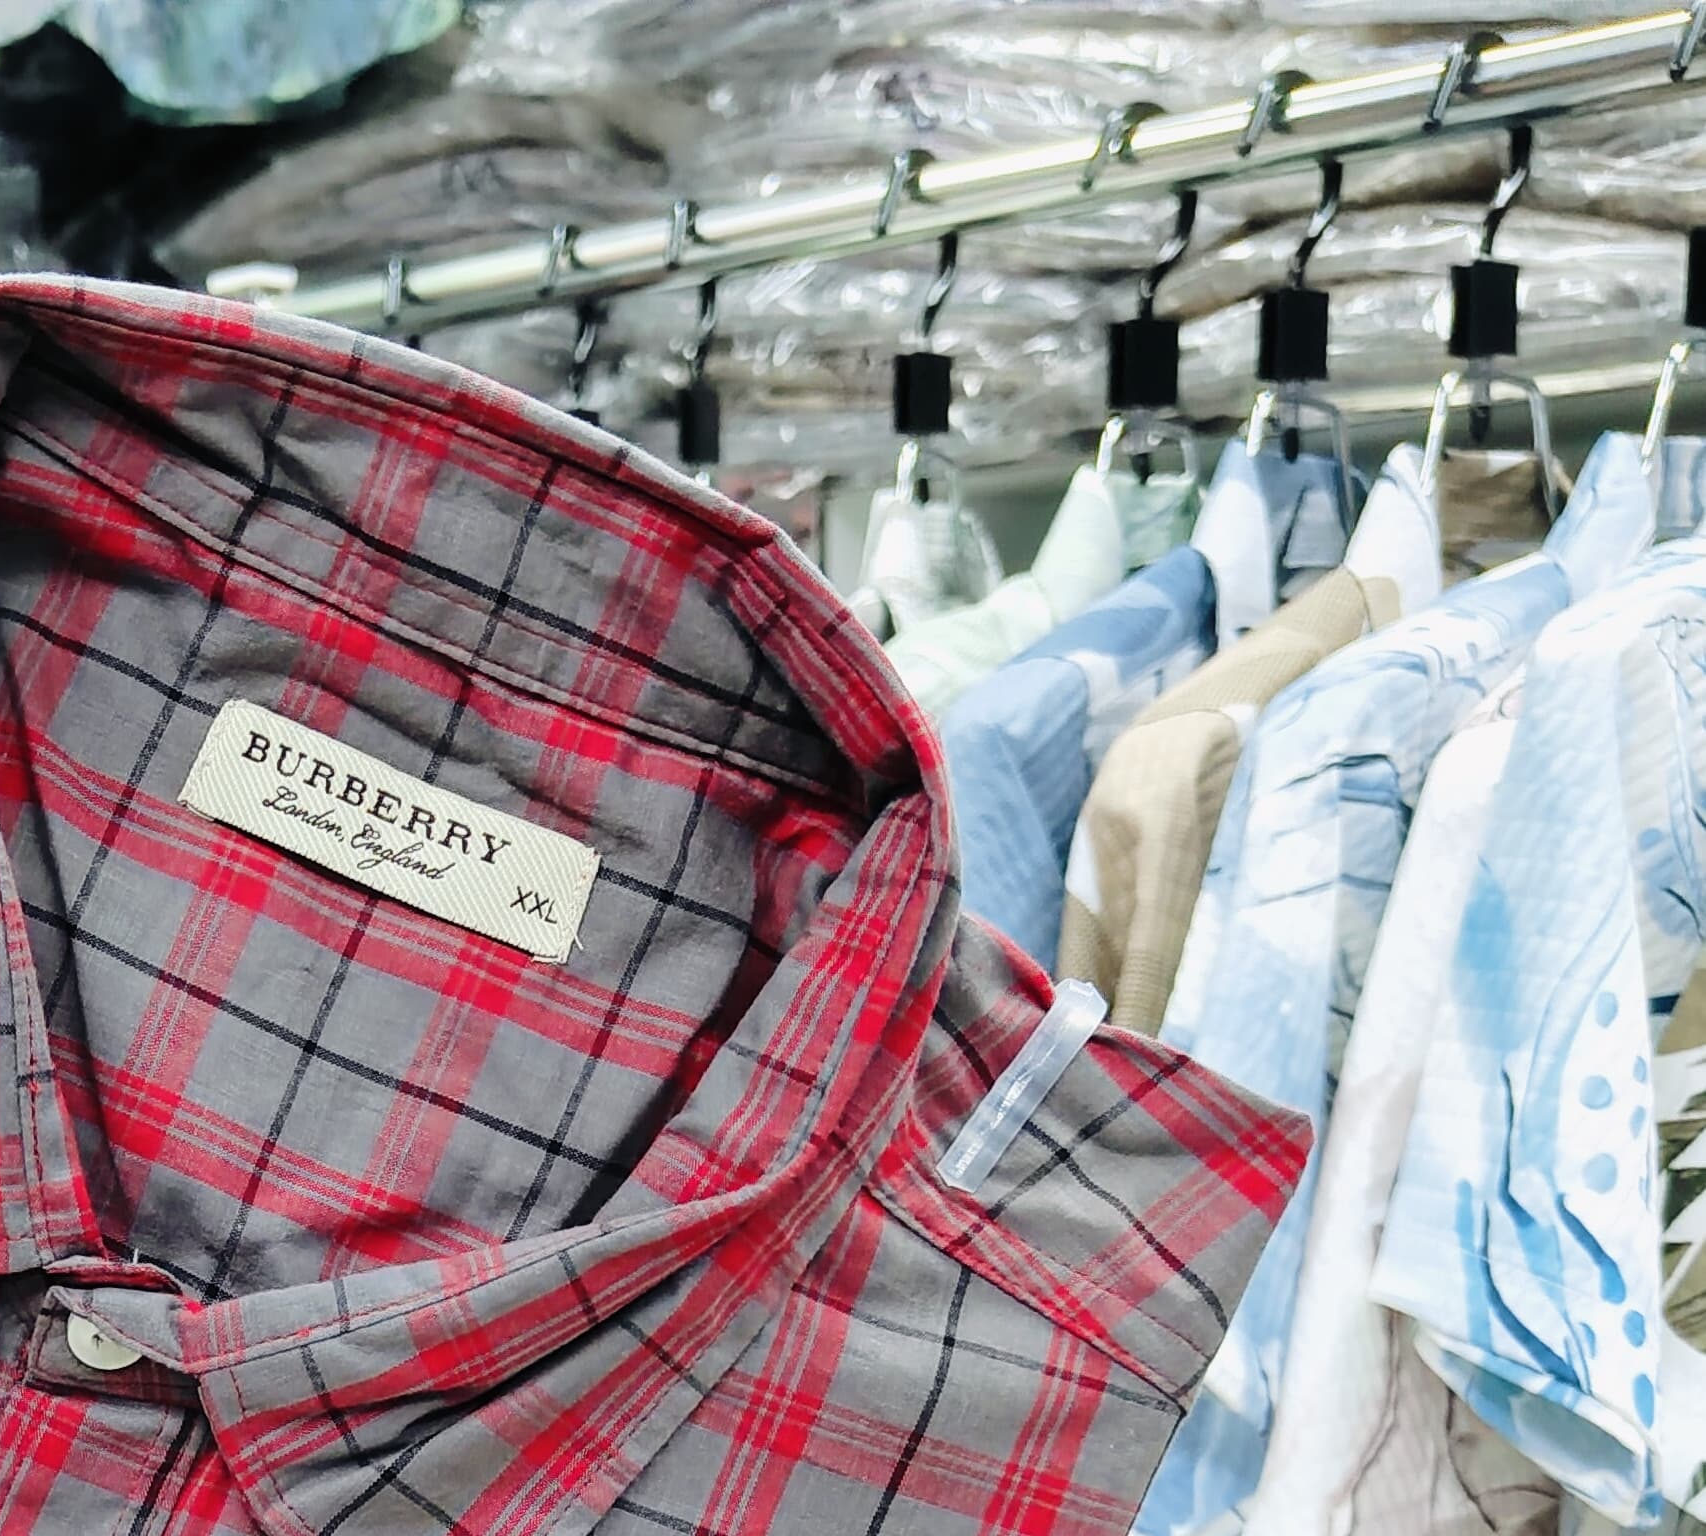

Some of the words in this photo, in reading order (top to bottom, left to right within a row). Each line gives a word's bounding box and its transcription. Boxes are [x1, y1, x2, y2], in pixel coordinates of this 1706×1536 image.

[241, 730, 512, 865] BURBERRY
[262, 785, 346, 843] London,
[350, 823, 456, 881] England
[509, 886, 559, 925] XXL
